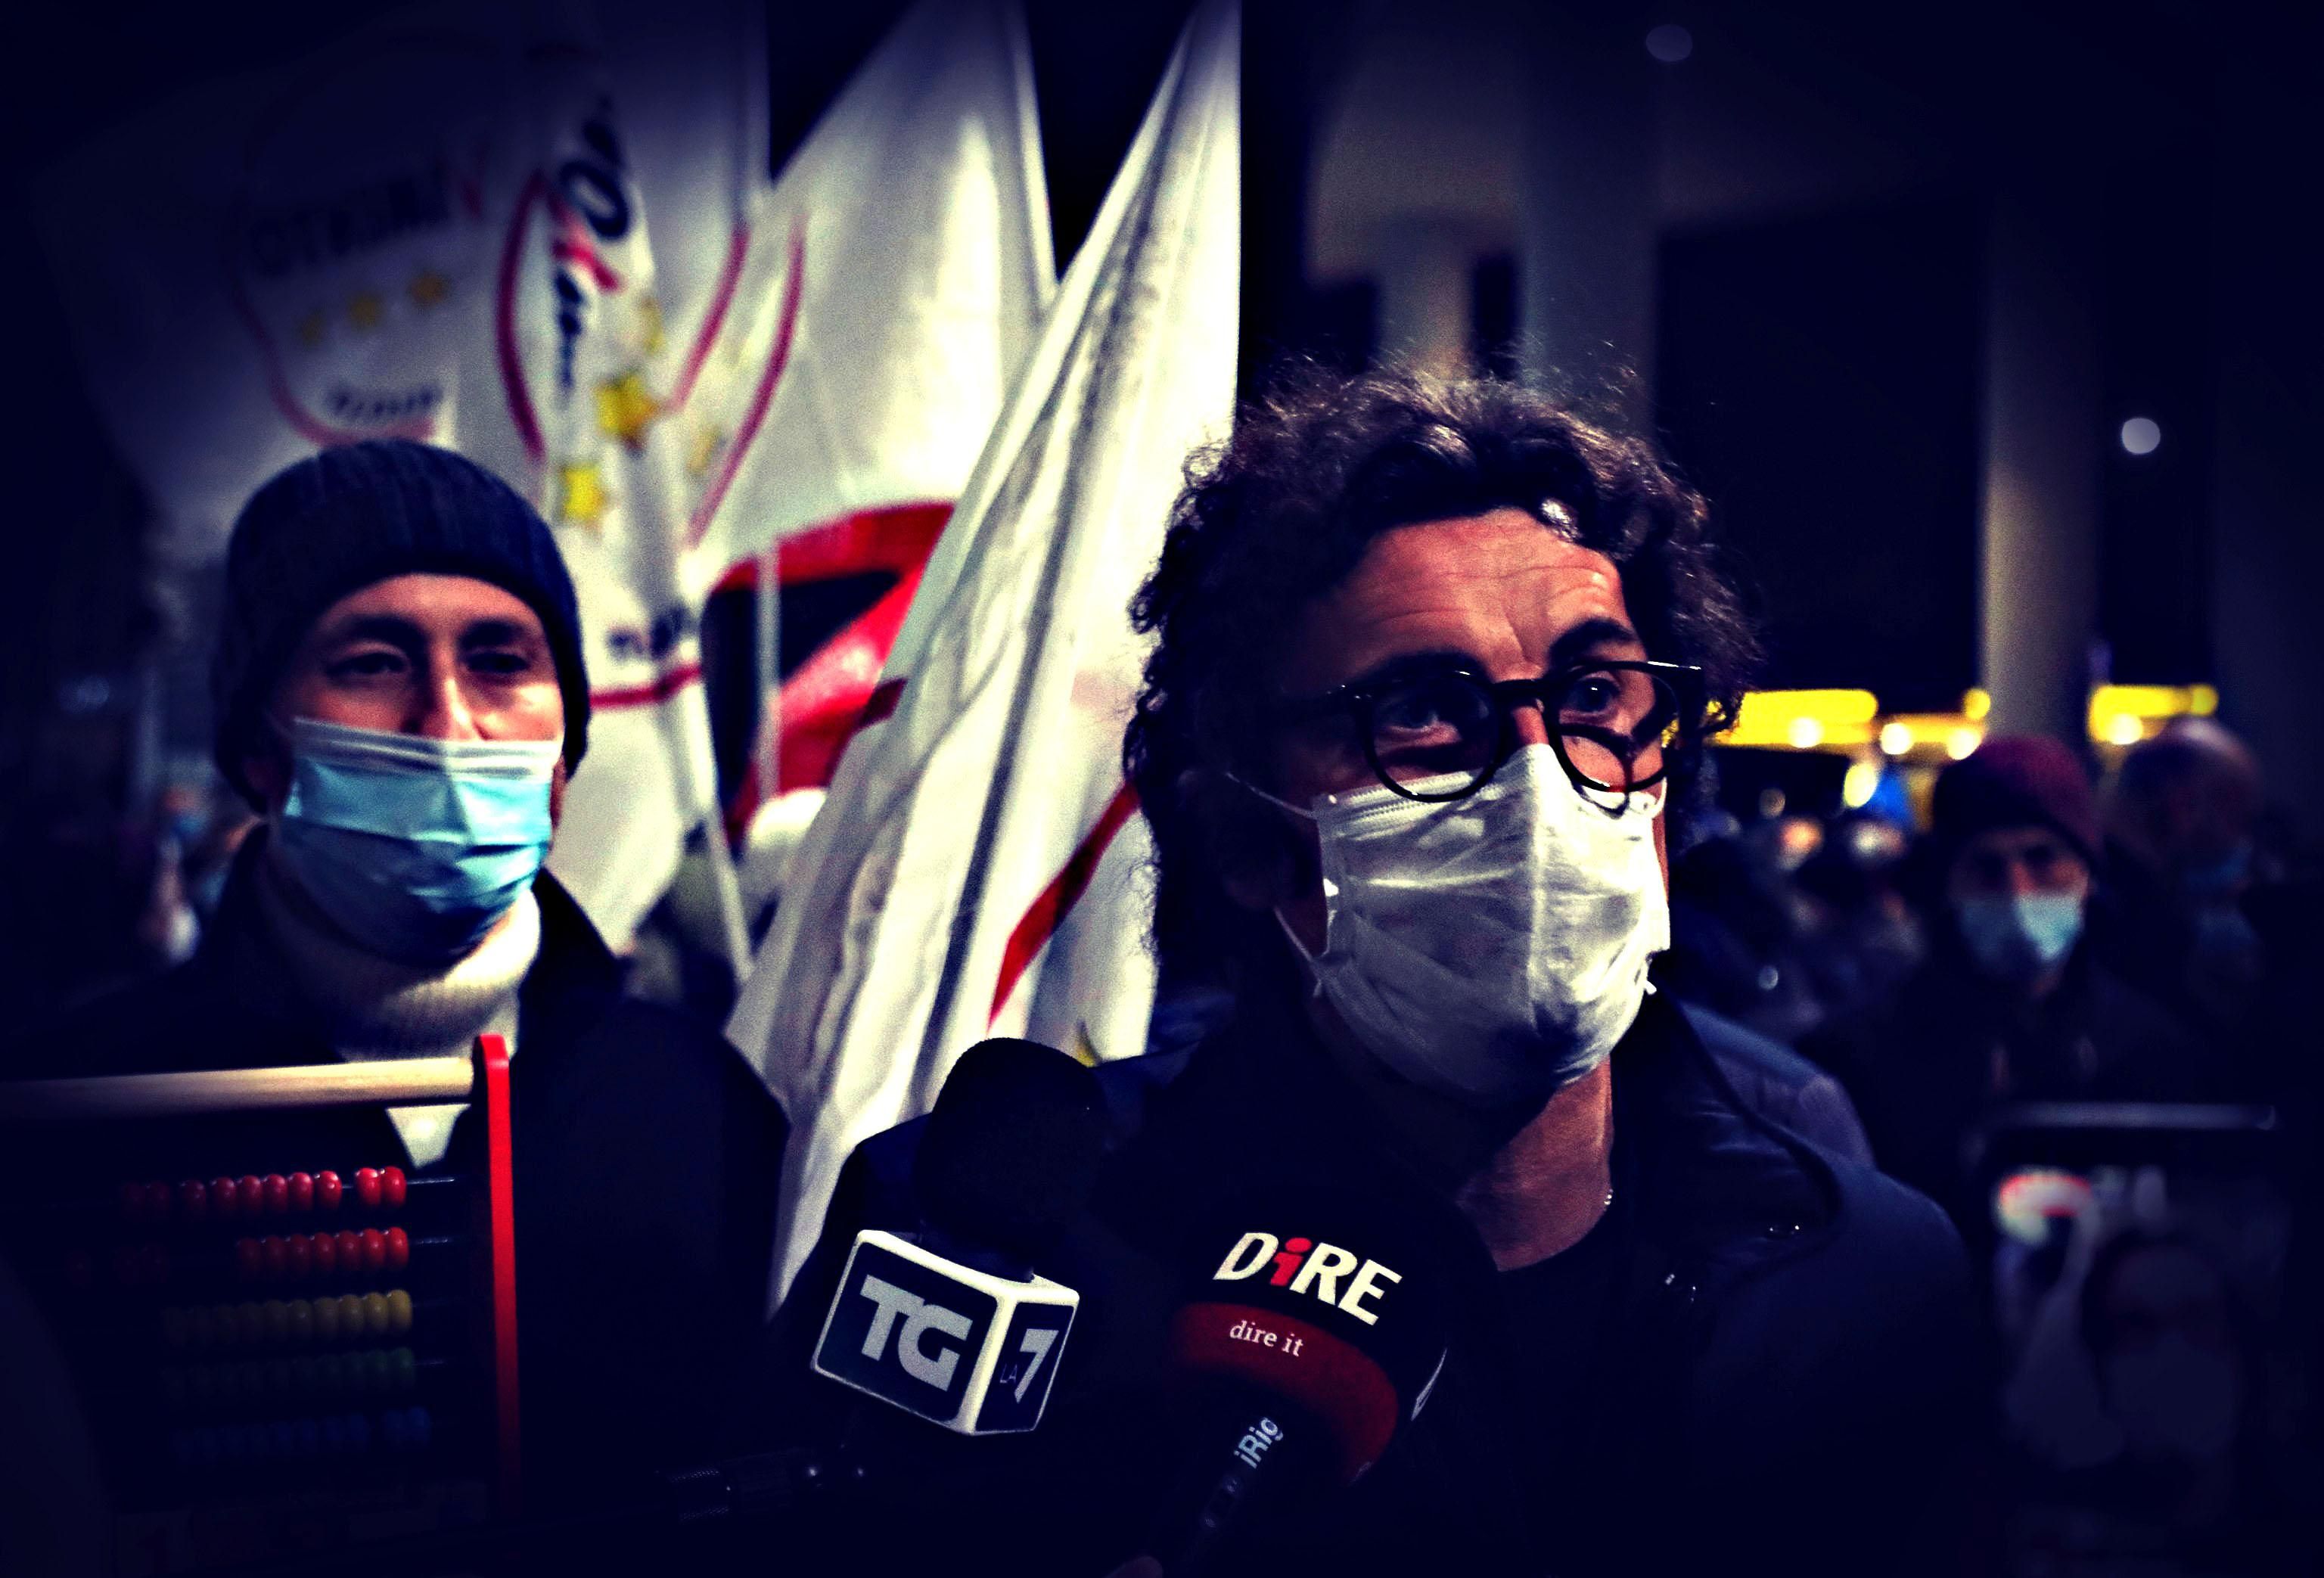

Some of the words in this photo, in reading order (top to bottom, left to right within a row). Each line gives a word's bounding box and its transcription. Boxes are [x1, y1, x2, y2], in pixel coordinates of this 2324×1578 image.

[1212, 1232, 1403, 1326] DiRE
[859, 1274, 974, 1392] TG
[1229, 1319, 1278, 1347] dire
[1282, 1333, 1304, 1357] it
[1233, 1416, 1284, 1469] iRig
